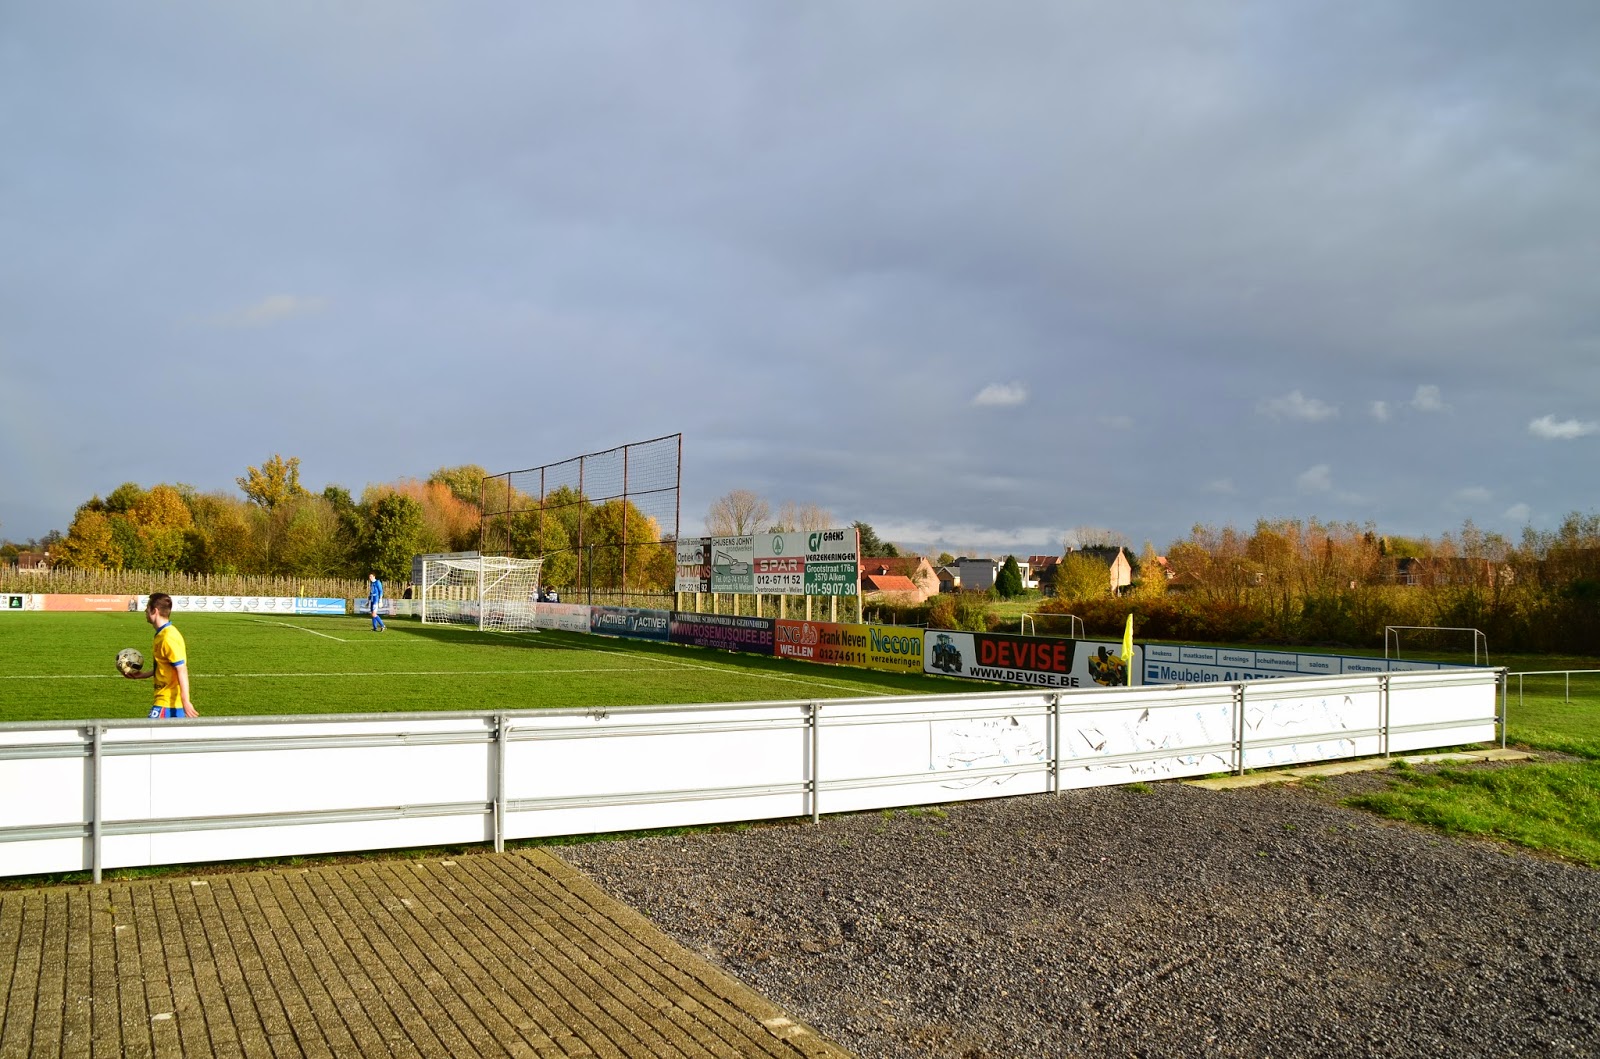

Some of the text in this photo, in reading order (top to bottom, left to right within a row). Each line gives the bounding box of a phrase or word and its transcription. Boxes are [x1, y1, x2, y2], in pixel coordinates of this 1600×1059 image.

[736, 537, 752, 546] JOHNY
[823, 531, 844, 541] GAENS
[677, 552, 694, 564] Optiek
[805, 553, 855, 562] VERZEKERINGEN
[676, 565, 711, 578] PUTMANS
[760, 559, 797, 572] SPAR
[806, 564, 854, 573] Grootstraat 176a
[757, 575, 801, 584] 012-67 11 52
[828, 573, 846, 581] Alken
[805, 583, 856, 595] 011-59 07 30
[602, 614, 626, 625] ACTIVER
[638, 617, 666, 629] ACTIVER
[671, 621, 773, 645] WWW.ROSEMUSQUEE.BE
[777, 625, 800, 644] ING
[820, 629, 867, 648] Frank Neven
[869, 628, 920, 656] Necon
[780, 644, 814, 657] WELLEN
[820, 648, 866, 663] 012 74 61 11
[981, 639, 1066, 671] DEVISÉ
[871, 655, 920, 668] verzekeringen
[1223, 655, 1249, 663] dressings
[1347, 664, 1382, 672] eetkamers
[970, 667, 1080, 688] WWW.DEVISE.BE
[1160, 666, 1219, 683] Meubelen
